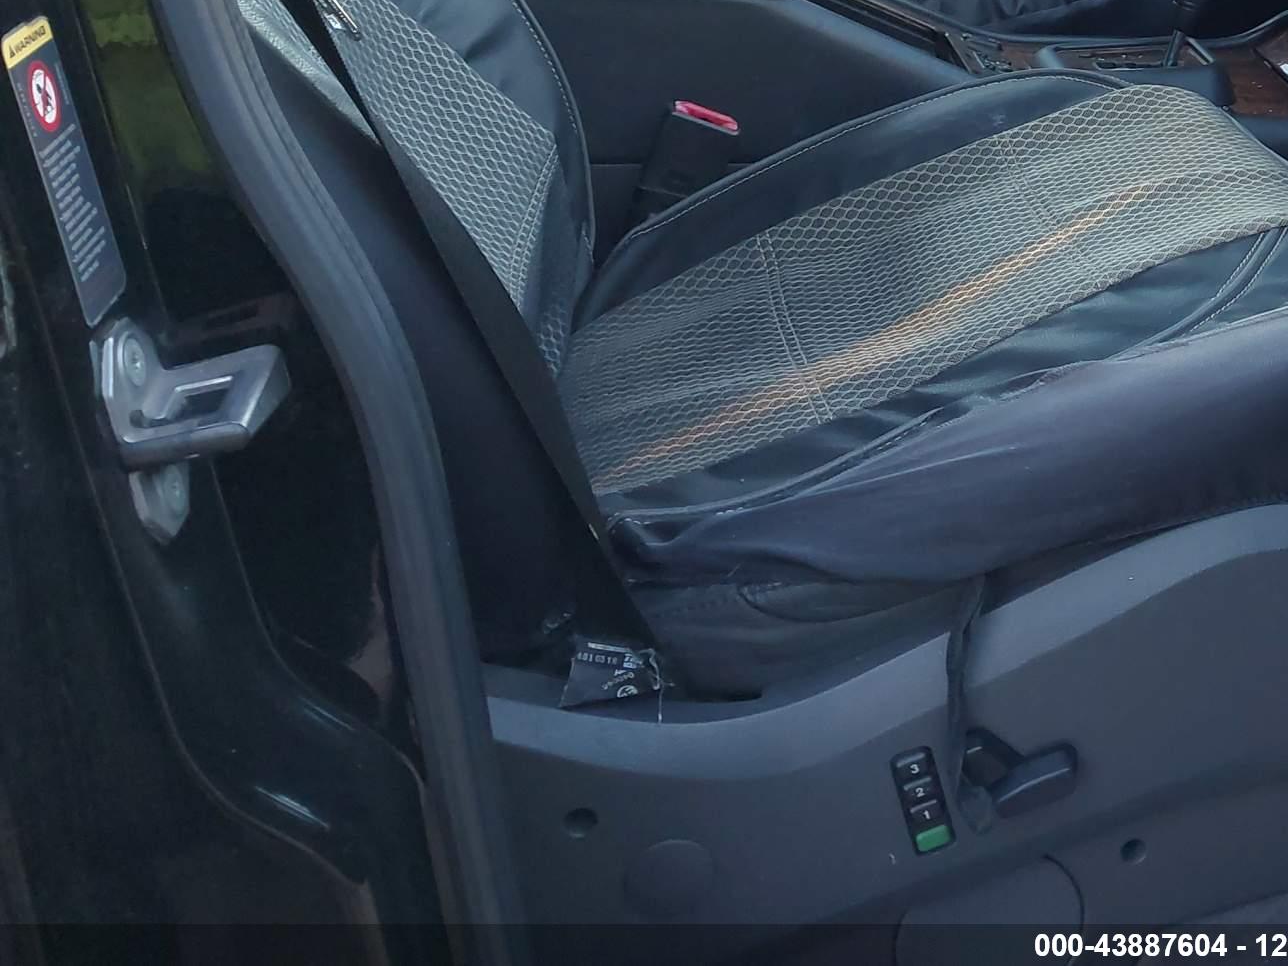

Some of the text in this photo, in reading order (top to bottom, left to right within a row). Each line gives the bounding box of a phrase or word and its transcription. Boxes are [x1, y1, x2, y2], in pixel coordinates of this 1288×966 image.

[14, 25, 46, 53] WARNING
[910, 764, 920, 774] 3
[915, 787, 926, 798] 2
[923, 810, 931, 820] 1
